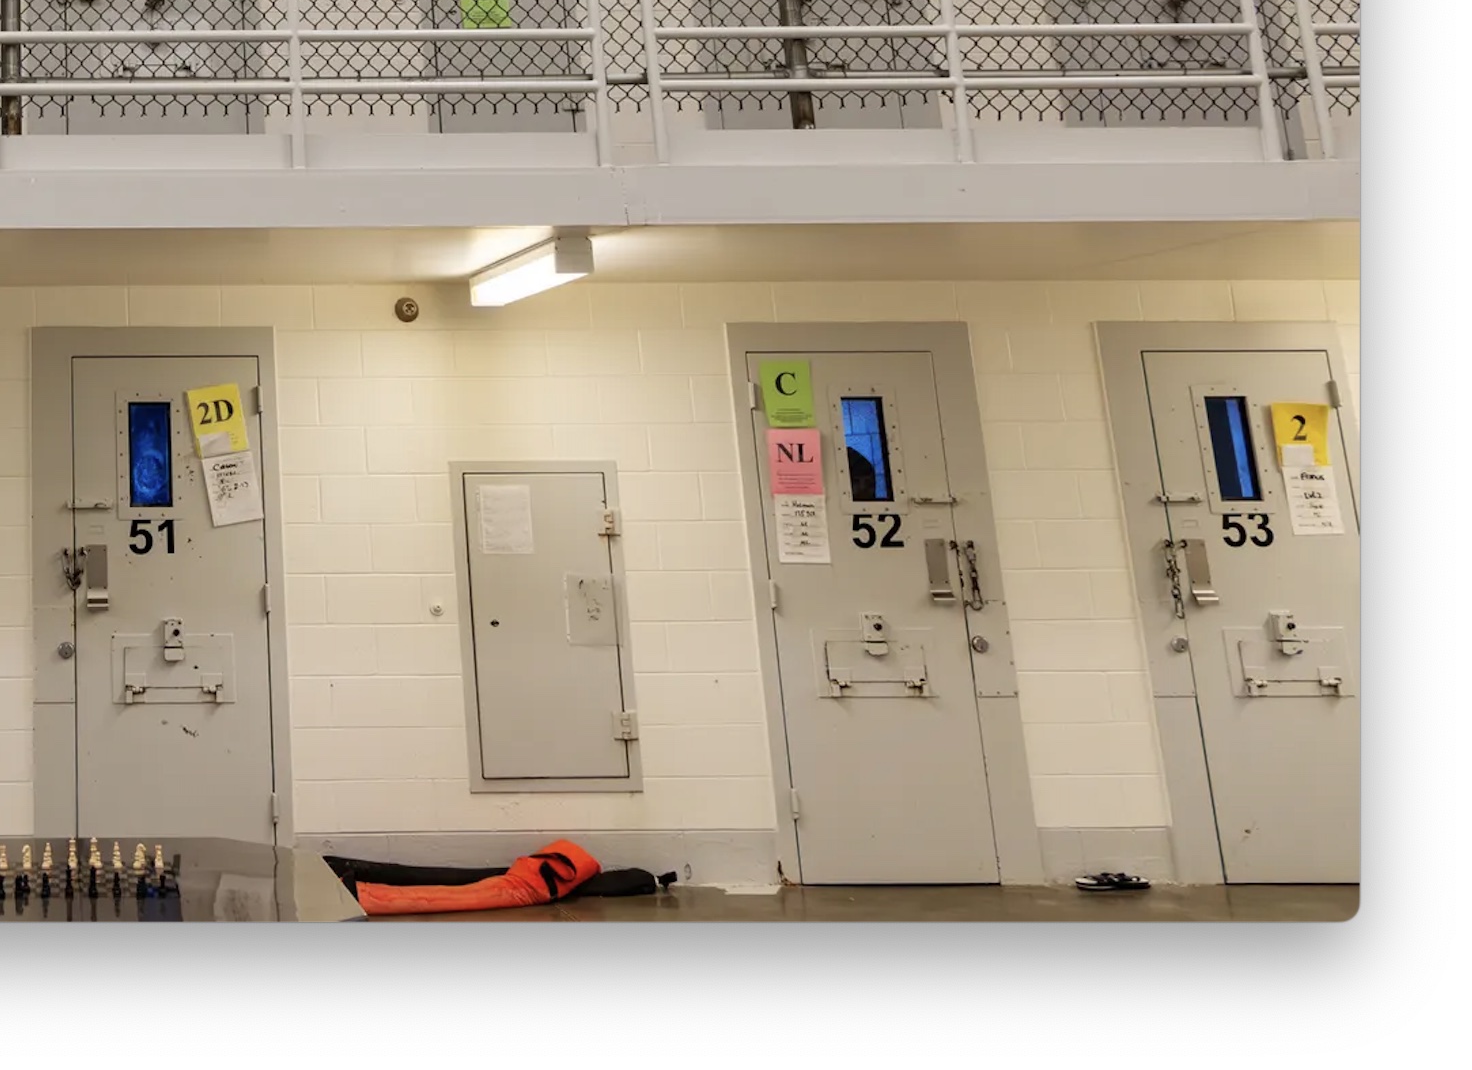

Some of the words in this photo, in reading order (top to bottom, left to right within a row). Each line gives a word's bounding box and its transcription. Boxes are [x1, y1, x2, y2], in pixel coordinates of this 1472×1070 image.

[775, 372, 797, 396] C
[197, 399, 234, 425] 2D
[1292, 414, 1307, 441] 2
[776, 442, 814, 463] NL
[129, 520, 175, 555] 51
[852, 514, 905, 549] 52
[1222, 513, 1274, 548] 53
